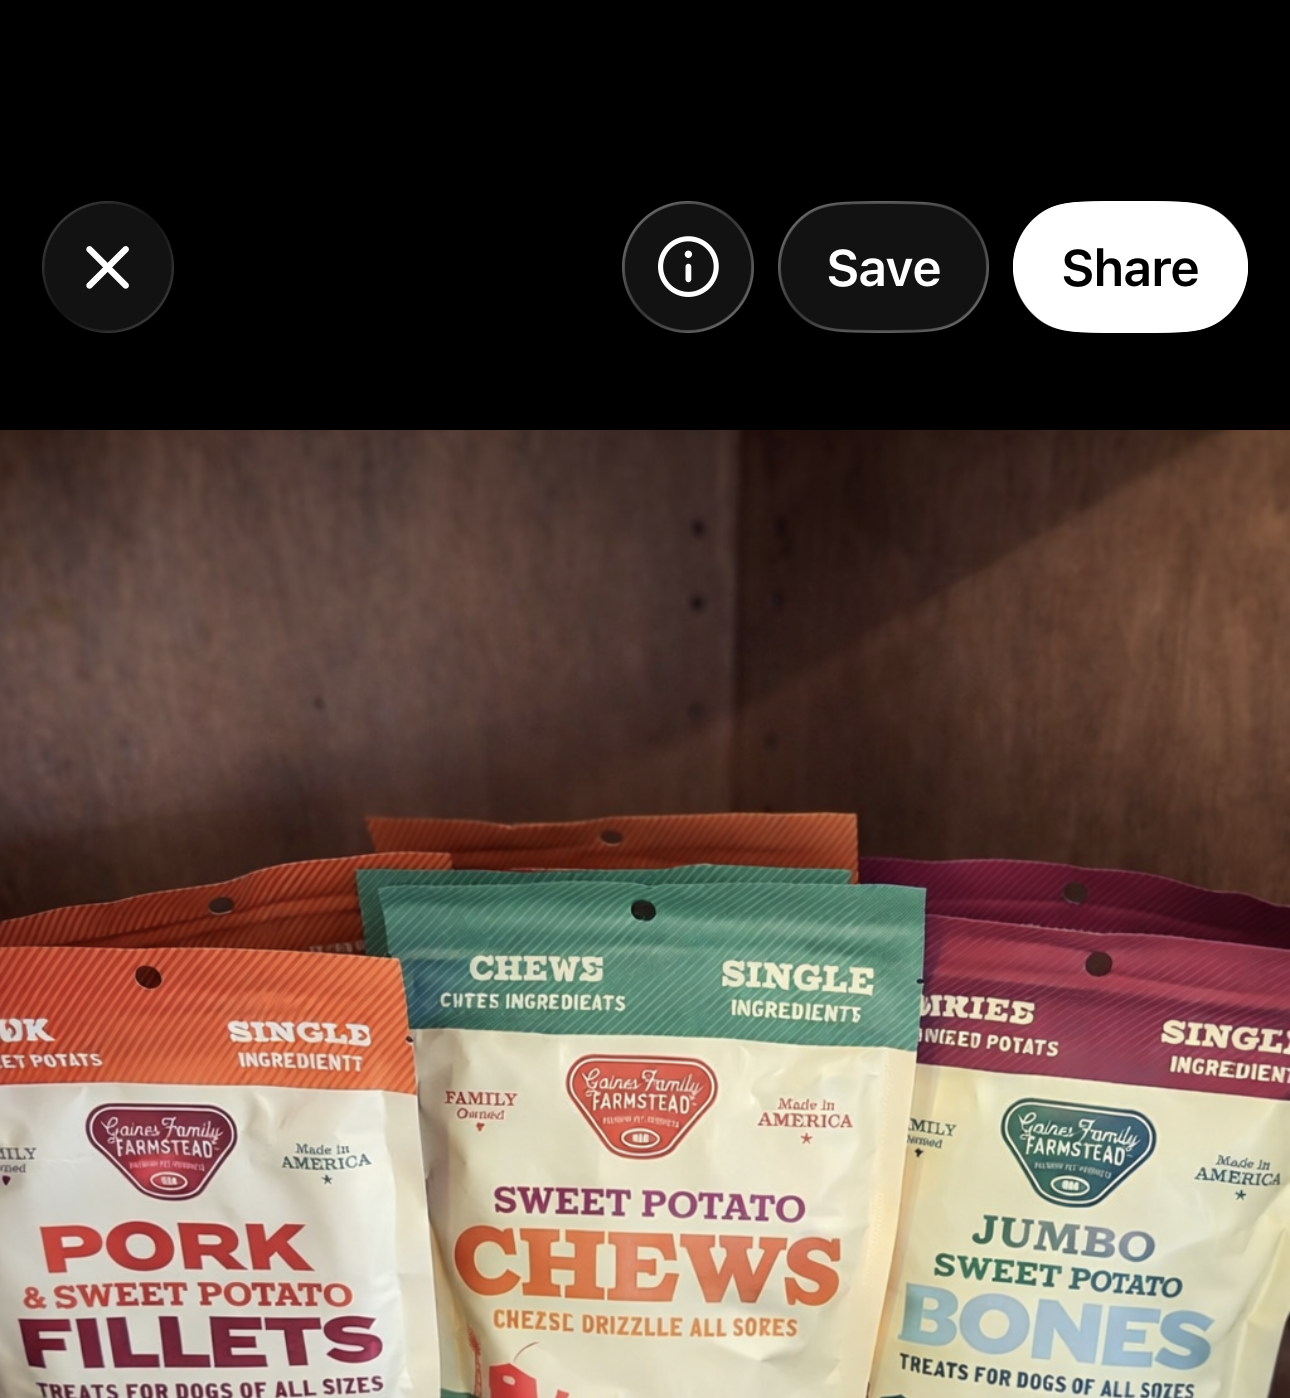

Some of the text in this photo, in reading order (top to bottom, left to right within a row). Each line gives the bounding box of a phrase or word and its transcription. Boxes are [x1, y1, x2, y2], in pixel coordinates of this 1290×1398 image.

[469, 955, 604, 982] CHEWS
[722, 959, 874, 996] SINGLE
[227, 1020, 372, 1047] SINGLE
[986, 1034, 1059, 1057] POTATS
[29, 1052, 103, 1068] POTATS
[1170, 1055, 1290, 1084] INGREDIEN
[582, 1068, 703, 1100] Gaines Family
[444, 1090, 518, 1107] FAMILY
[592, 1092, 690, 1115] FARMSTEAD
[777, 1098, 818, 1111] Made
[100, 1116, 223, 1145] Gaines Family
[757, 1112, 853, 1128] AMERICA
[908, 1118, 957, 1137] MILY
[1018, 1112, 1141, 1151] Gaines Family
[116, 1138, 213, 1159] FARMSTEAD
[282, 1153, 372, 1171] AMERICA
[295, 1143, 331, 1155] Made
[1025, 1137, 1126, 1166] FARMSTEAD
[1216, 1155, 1254, 1169] Made
[1194, 1167, 1281, 1186] AMERICA
[494, 1186, 806, 1223] SWEET POTATO
[40, 1220, 315, 1273] PORK
[972, 1214, 1156, 1262] JUMBO
[454, 1225, 841, 1306] CHEWS
[933, 1253, 1183, 1298] SWEET POTATO
[23, 1281, 353, 1309] & SWEET POTATO
[582, 1314, 683, 1336] DRIZZLLE
[690, 1317, 727, 1337] ALL
[898, 1282, 1215, 1370] BONES
[18, 1315, 384, 1369] FILLETS
[240, 1381, 266, 1398] OF
[275, 1379, 316, 1398] ALL
[322, 1375, 384, 1395] SIZES
[900, 1353, 968, 1380] TREATS
[974, 1366, 1011, 1387] FOR
[1016, 1371, 1067, 1393] DOGS
[1072, 1377, 1095, 1396] OF
[1100, 1380, 1135, 1398] ALL
